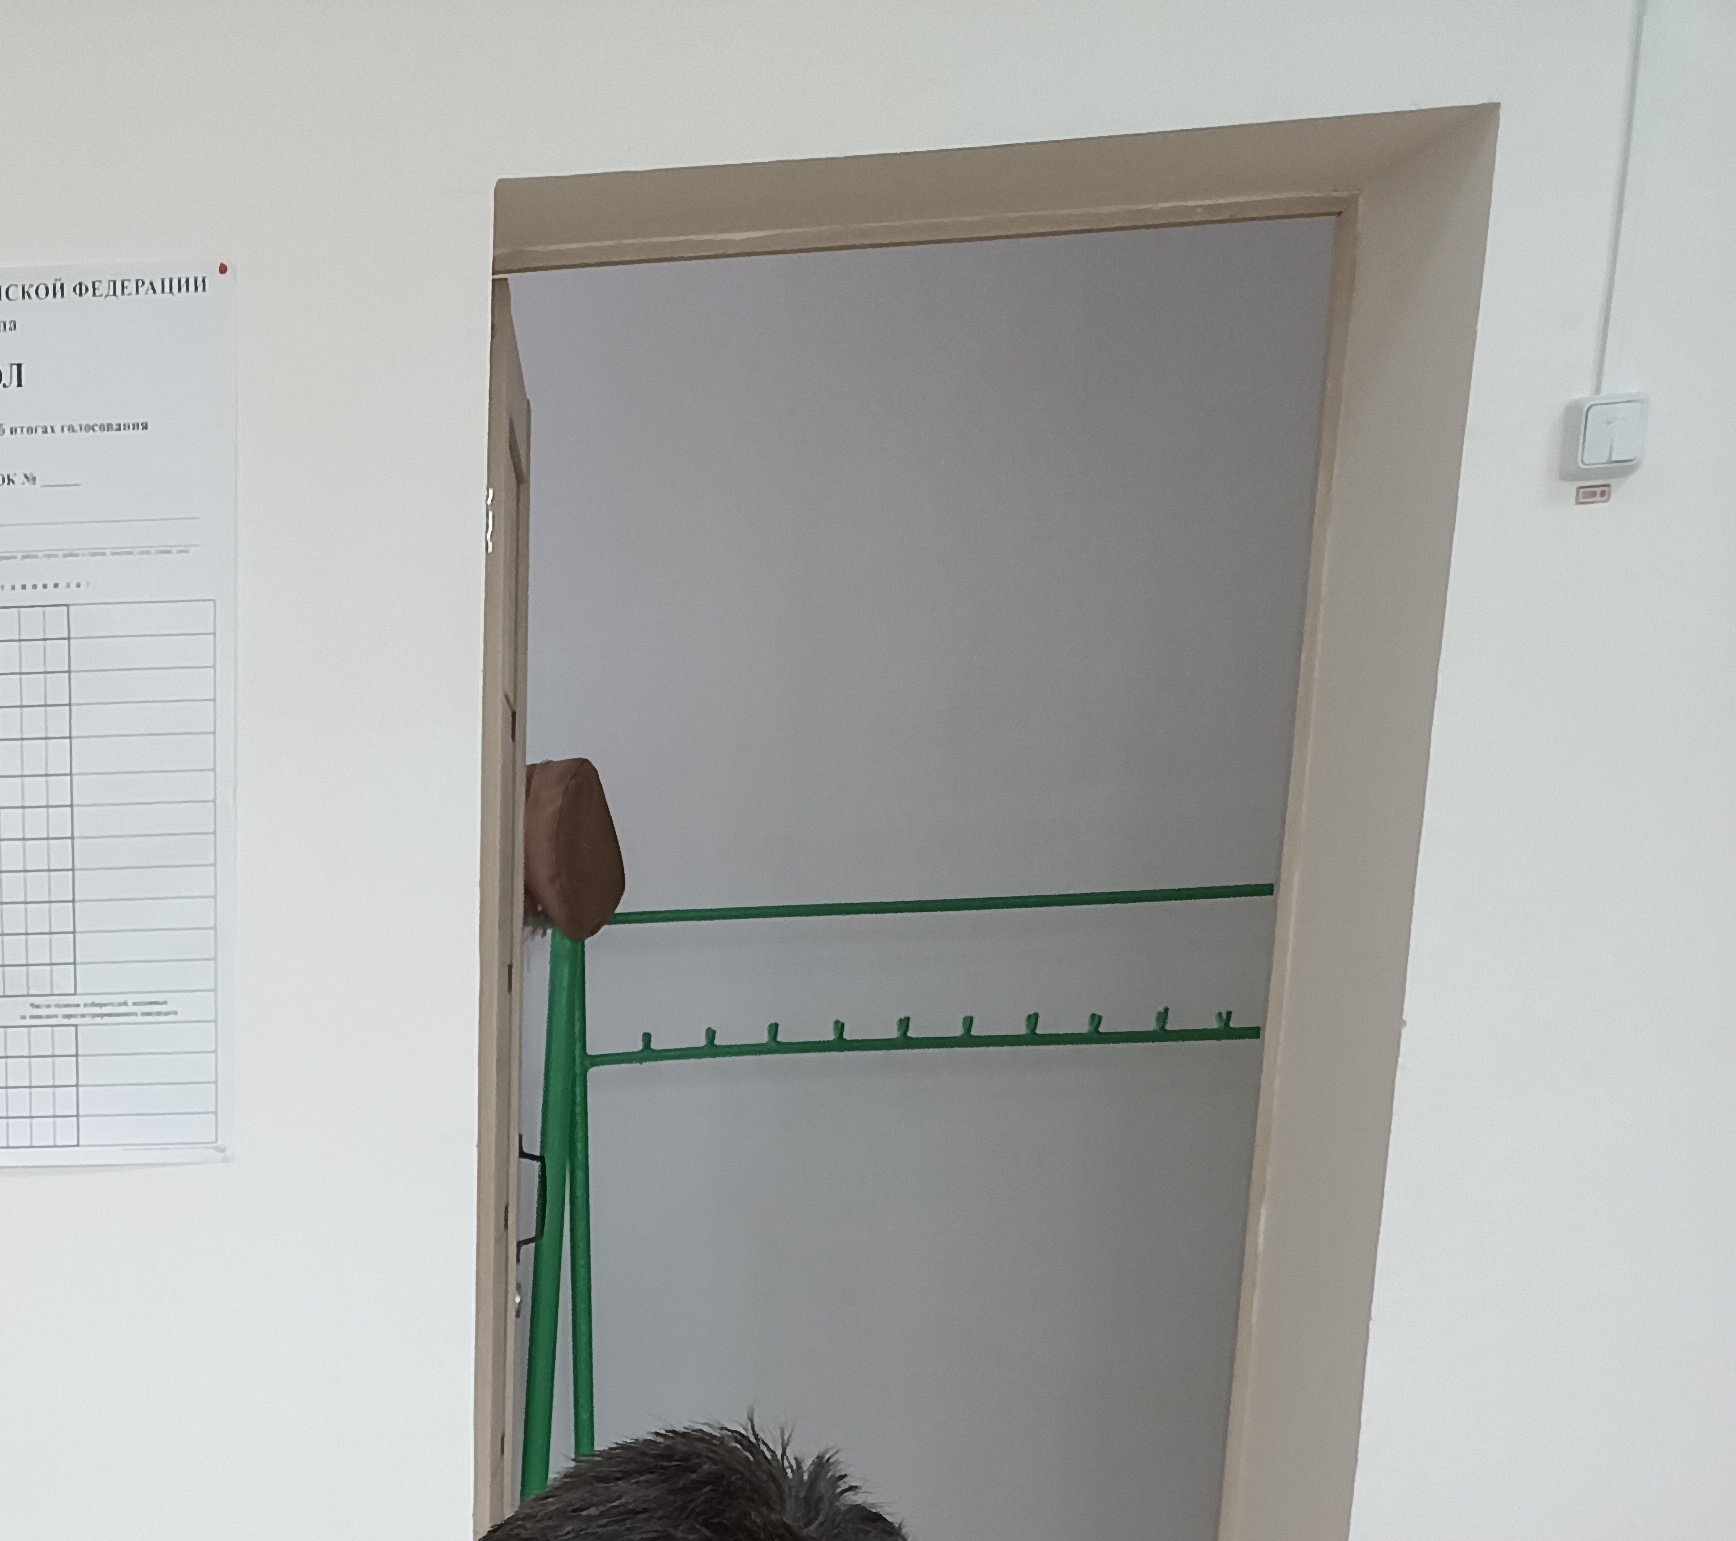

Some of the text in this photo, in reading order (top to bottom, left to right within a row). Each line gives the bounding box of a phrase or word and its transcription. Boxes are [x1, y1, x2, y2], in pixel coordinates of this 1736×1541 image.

[72, 275, 208, 300] ФЕДЕРАЦИИ
[9, 421, 57, 437] итогах
[60, 420, 150, 436] голосования
